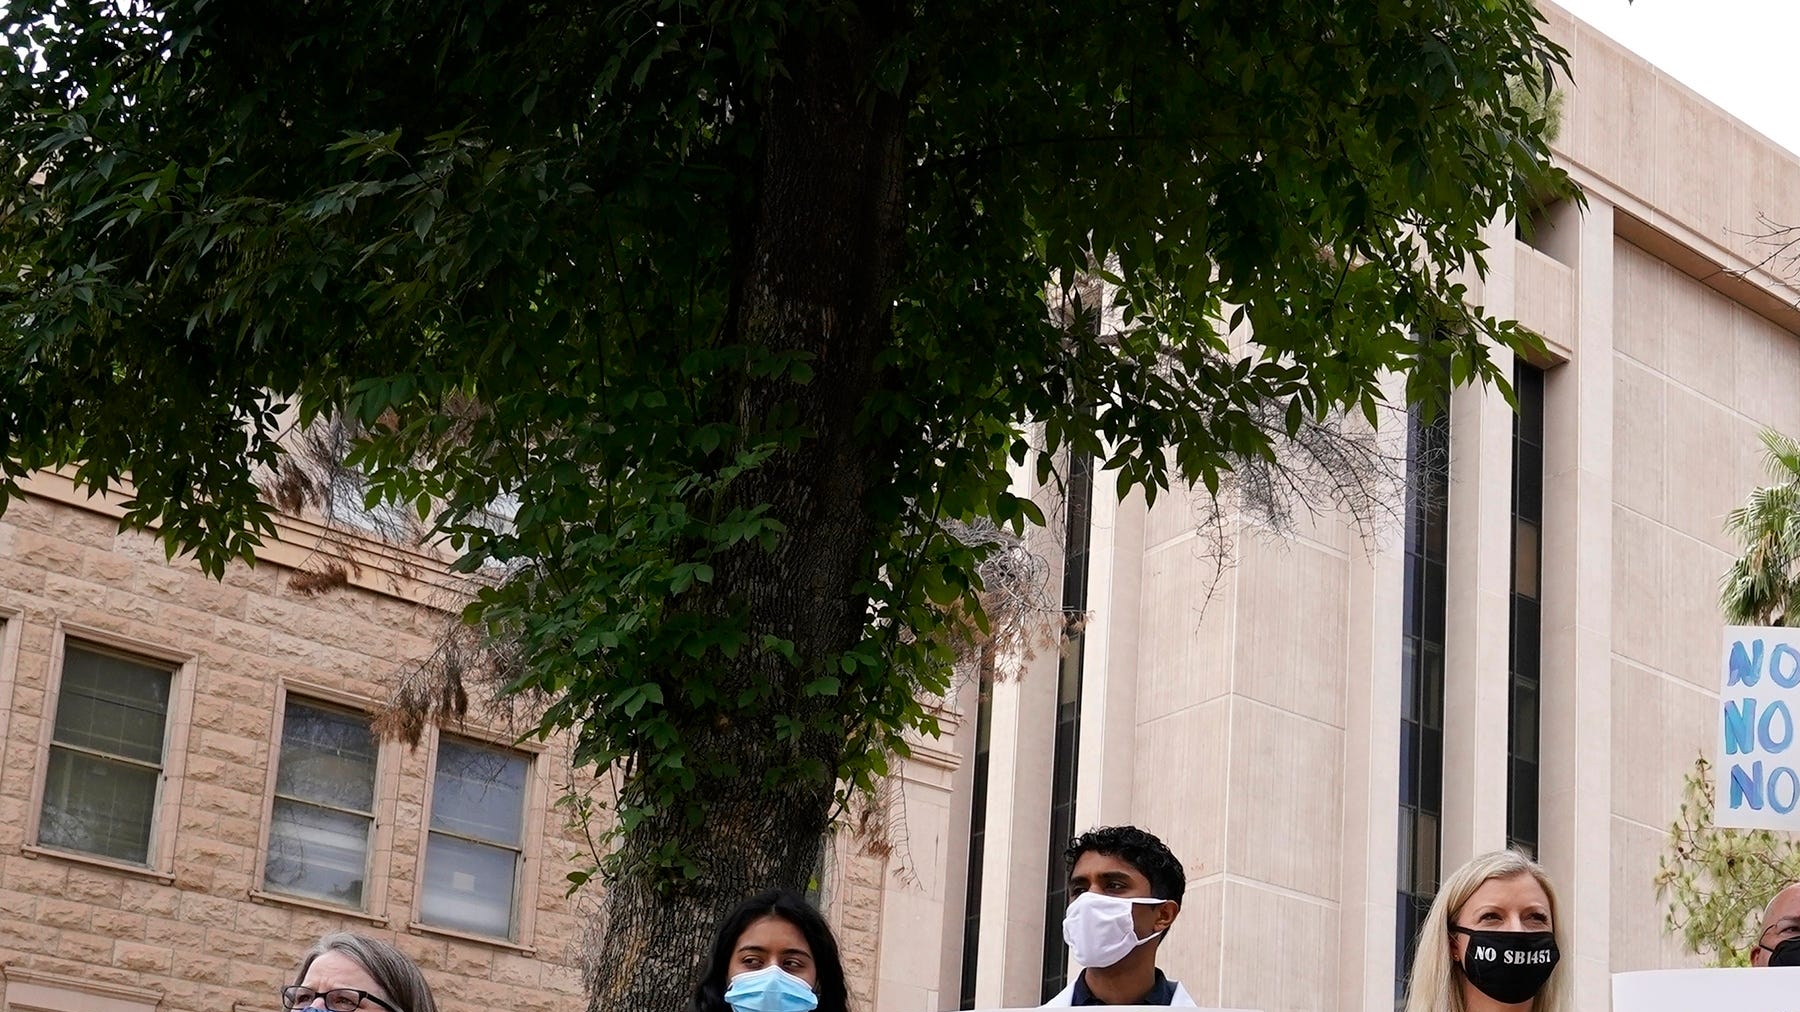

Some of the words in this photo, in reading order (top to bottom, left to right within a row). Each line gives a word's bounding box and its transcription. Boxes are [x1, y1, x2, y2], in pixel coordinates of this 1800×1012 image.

[1723, 698, 1795, 756] NO
[1729, 761, 1800, 815] NO
[1474, 946, 1497, 962] NO
[1503, 949, 1551, 965] SB1457
